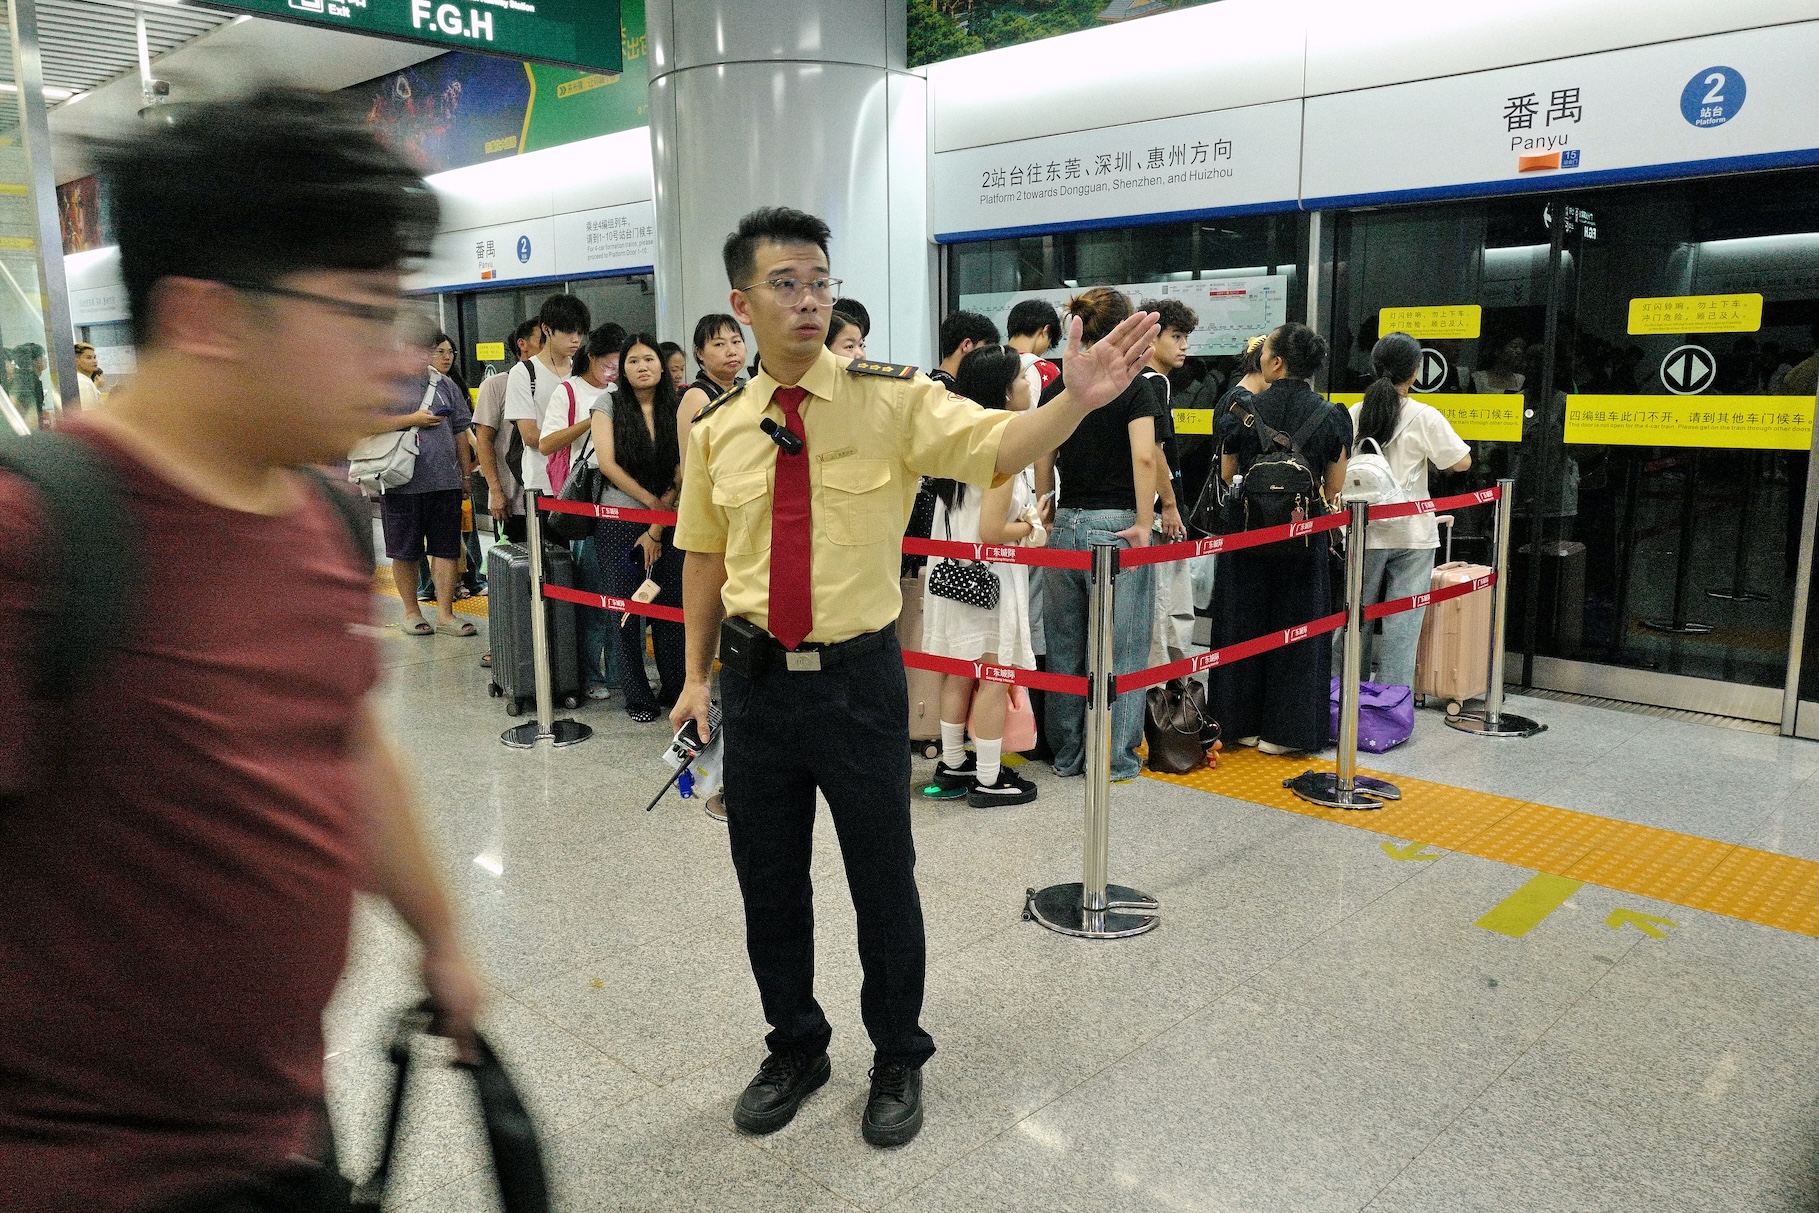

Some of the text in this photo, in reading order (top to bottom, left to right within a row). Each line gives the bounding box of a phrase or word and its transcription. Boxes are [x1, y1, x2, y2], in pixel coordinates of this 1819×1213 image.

[328, 3, 350, 18] Exit
[411, 0, 493, 41] F.G.H
[1701, 72, 1726, 104] 2
[1502, 87, 1583, 132] 番禺
[1700, 106, 1724, 118] 站台
[1695, 116, 1726, 126] Platform
[1511, 134, 1569, 151] Panyu
[982, 139, 1233, 188] 2站台往东莞、深圳、惠州方向
[1565, 150, 1577, 160] 15
[980, 166, 1233, 205] Platform 2 towards Dongguan, Shenzhen, and Huizhou
[476, 240, 495, 259] 番禺
[521, 238, 527, 253] 2
[479, 261, 493, 269] Panyu
